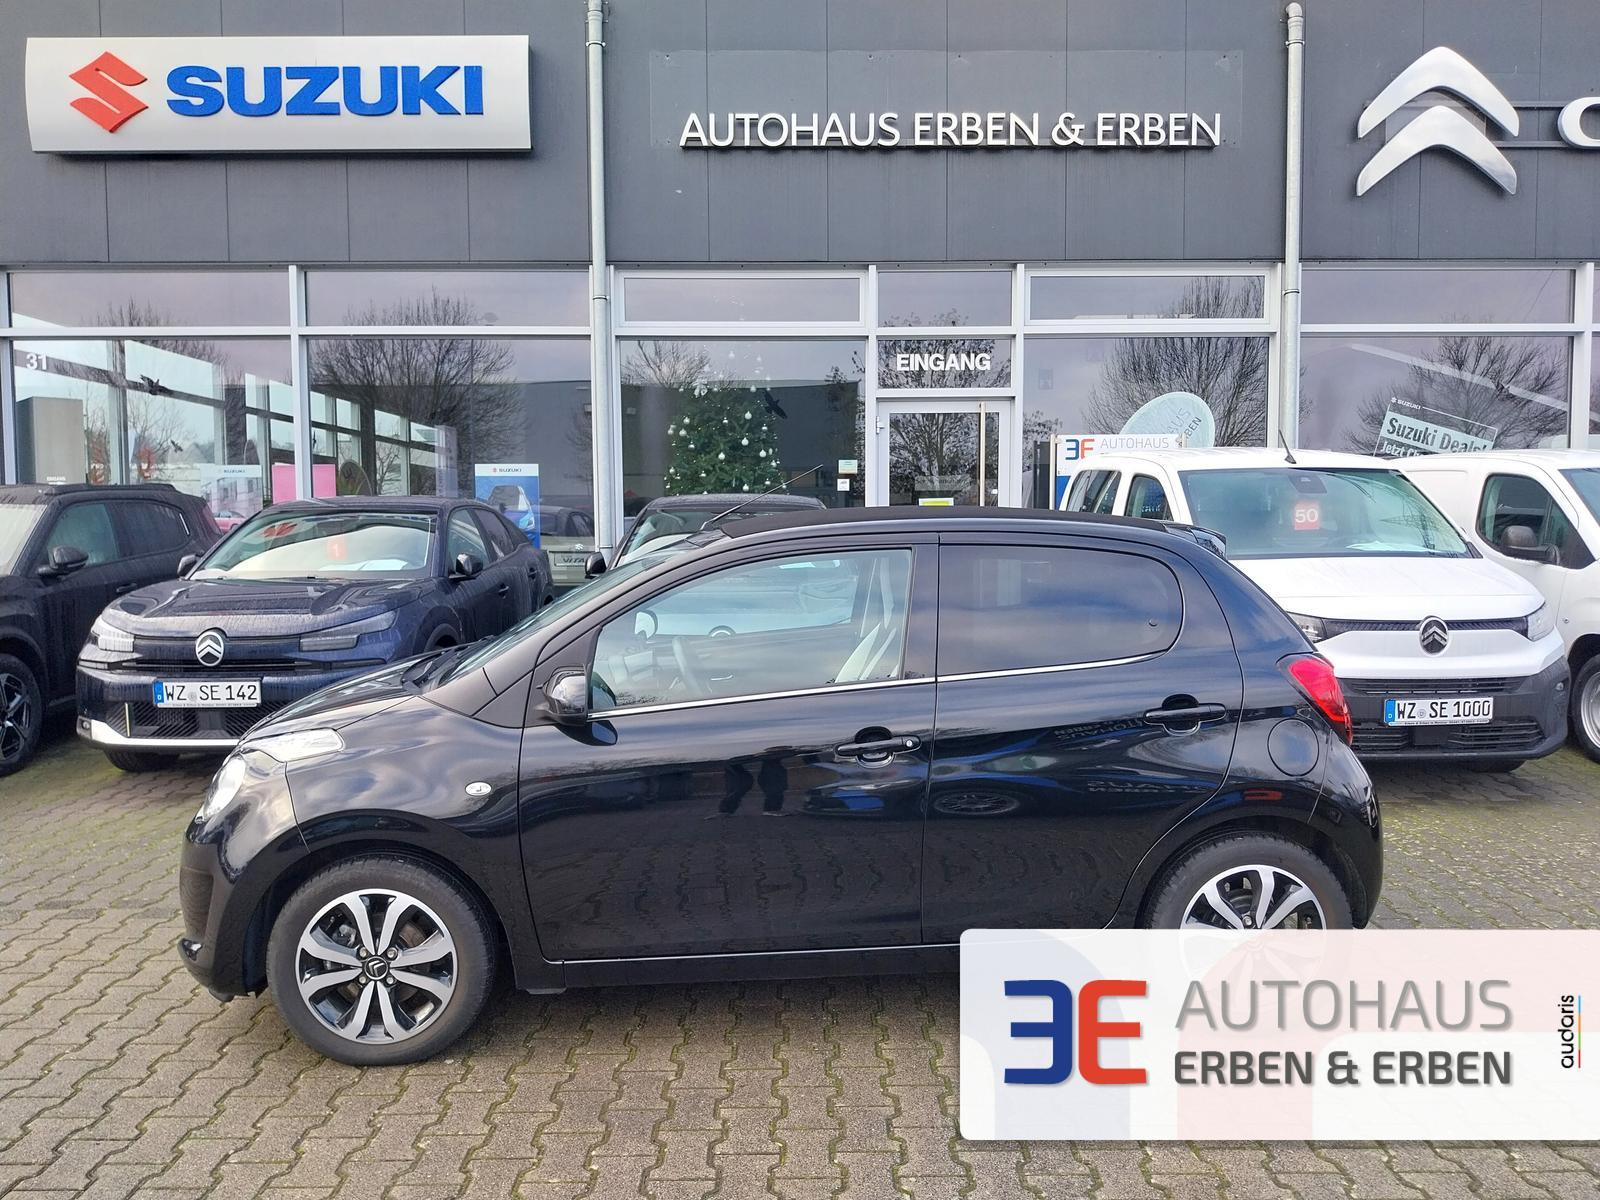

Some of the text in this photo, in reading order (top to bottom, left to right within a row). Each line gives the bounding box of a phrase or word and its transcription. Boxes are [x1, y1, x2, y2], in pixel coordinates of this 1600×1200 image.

[166, 65, 484, 116] SUZUKI
[679, 112, 1221, 147] AUTOHAUS ERBEN & ERBEN
[26, 353, 47, 370] 31
[896, 353, 991, 371] EINGANG
[1397, 399, 1421, 410] SUZUKI
[1387, 417, 1438, 447] Suzuki
[1100, 437, 1170, 449] AUTOHAUS
[1296, 509, 1318, 523] 50
[165, 685, 257, 701] WZ SE 142
[1397, 700, 1490, 719] WZ SE 1000
